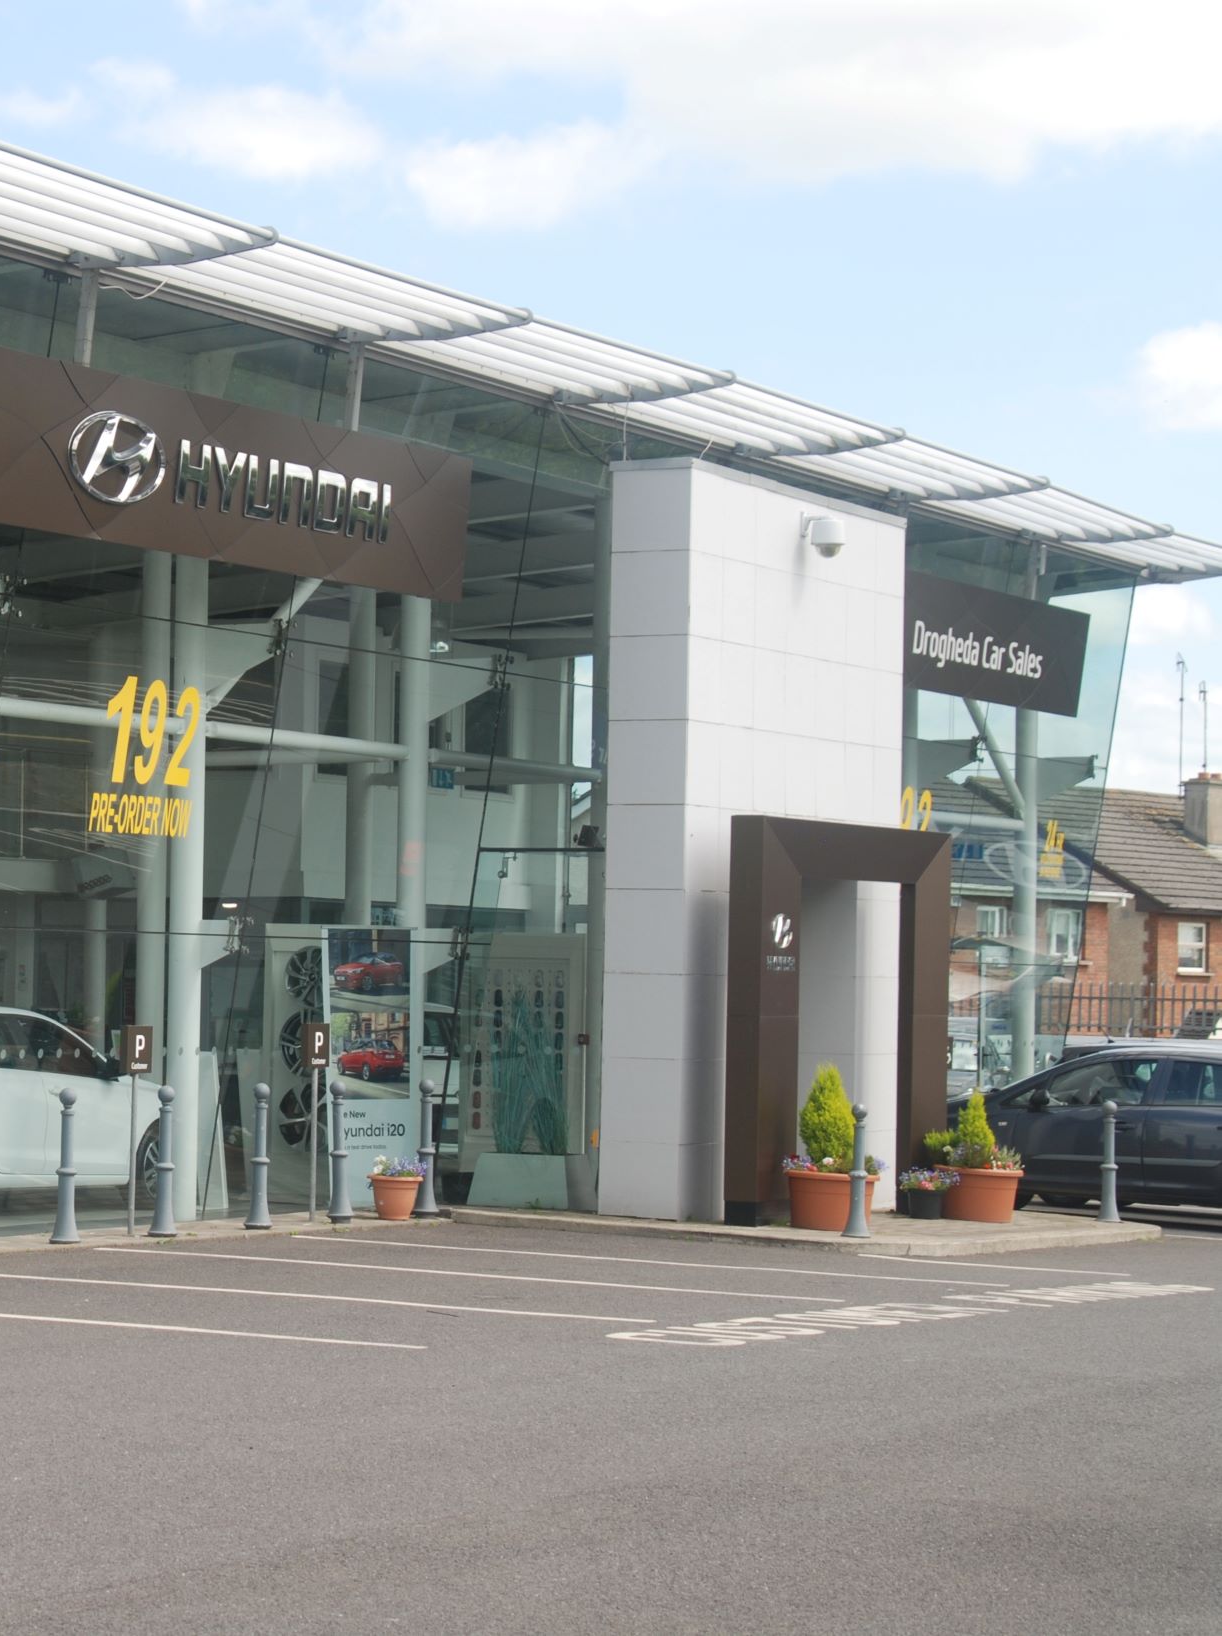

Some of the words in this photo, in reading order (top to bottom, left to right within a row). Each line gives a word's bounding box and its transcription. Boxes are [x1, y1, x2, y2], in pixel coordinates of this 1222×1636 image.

[175, 438, 392, 544] HYUNDAI
[912, 620, 980, 668] Drogheda
[982, 636, 1006, 671] Car
[1006, 642, 1043, 679] Sales
[106, 675, 201, 787] 192
[88, 792, 161, 835] PRE-ORDER
[160, 798, 193, 838] NOW
[135, 1034, 145, 1059] P
[314, 1031, 324, 1054] P
[344, 1123, 385, 1140] yundai
[387, 1123, 406, 1137] i20
[349, 1110, 366, 1118] New
[605, 1302, 1009, 1346] CUSTOMER
